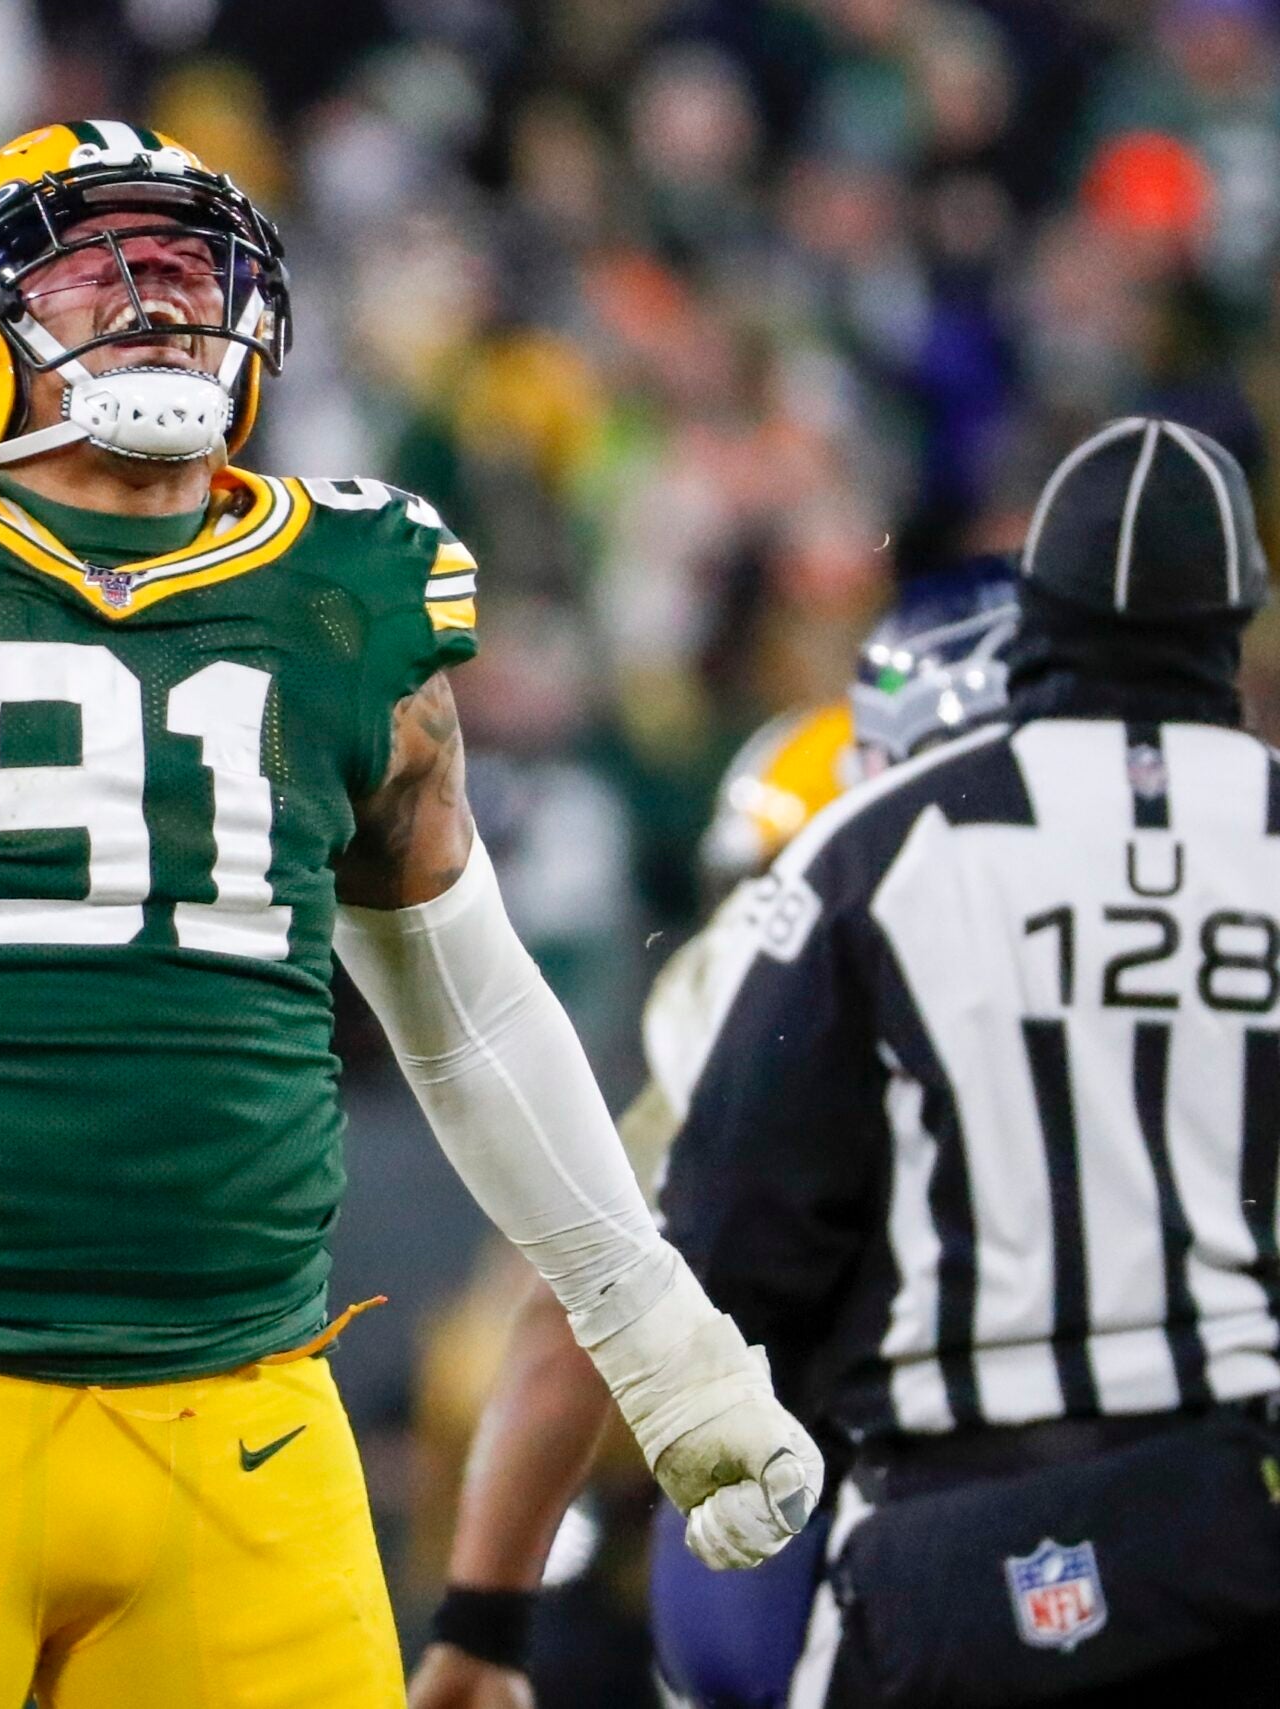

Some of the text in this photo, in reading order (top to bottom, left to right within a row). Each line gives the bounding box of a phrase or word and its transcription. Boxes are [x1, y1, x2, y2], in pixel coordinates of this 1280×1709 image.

[1126, 842, 1184, 897] U
[1024, 903, 1280, 1014] 128
[1027, 1583, 1094, 1632] NFL
